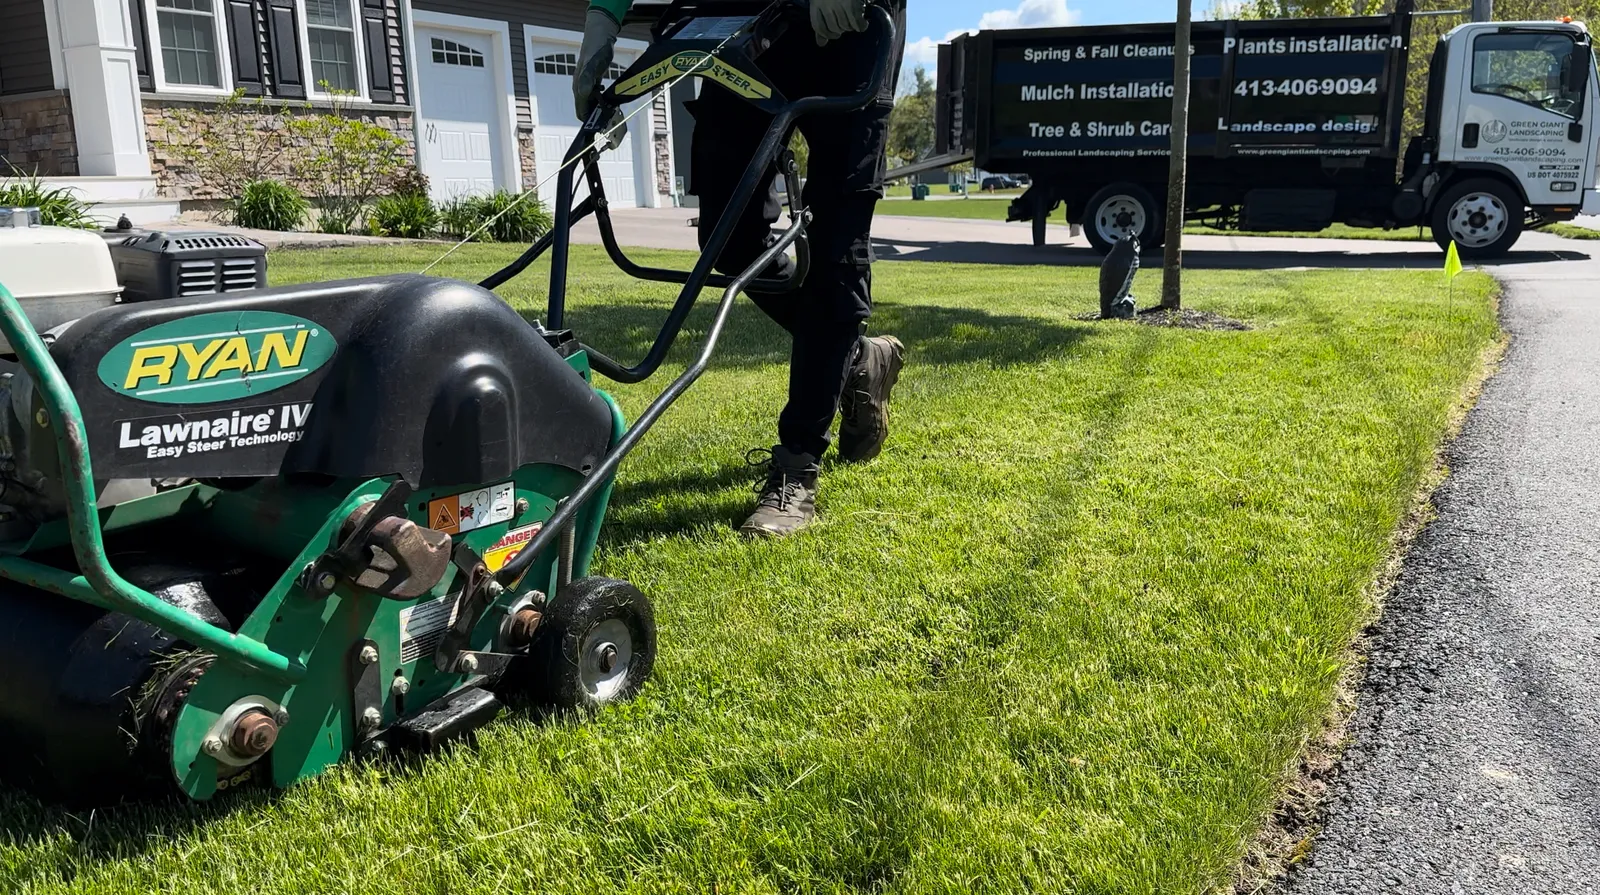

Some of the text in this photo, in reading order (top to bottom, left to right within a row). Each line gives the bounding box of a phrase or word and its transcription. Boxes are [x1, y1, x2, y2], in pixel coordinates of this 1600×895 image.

[1024, 44, 1195, 62] Spring & Fall Cleanus
[1224, 37, 1286, 54] Plants
[675, 57, 708, 66] RYAN
[640, 63, 669, 86] EASY
[712, 65, 751, 92] STEER
[1021, 82, 1174, 101] Mulch Installatio
[1029, 123, 1064, 137] Tree
[1070, 122, 1081, 136] &
[1087, 121, 1134, 136] Shrub
[1218, 118, 1316, 133] Landscape
[1493, 147, 1566, 156] 413-406-9094
[280, 403, 314, 429] IV
[146, 429, 305, 459] Easy Steer Technology
